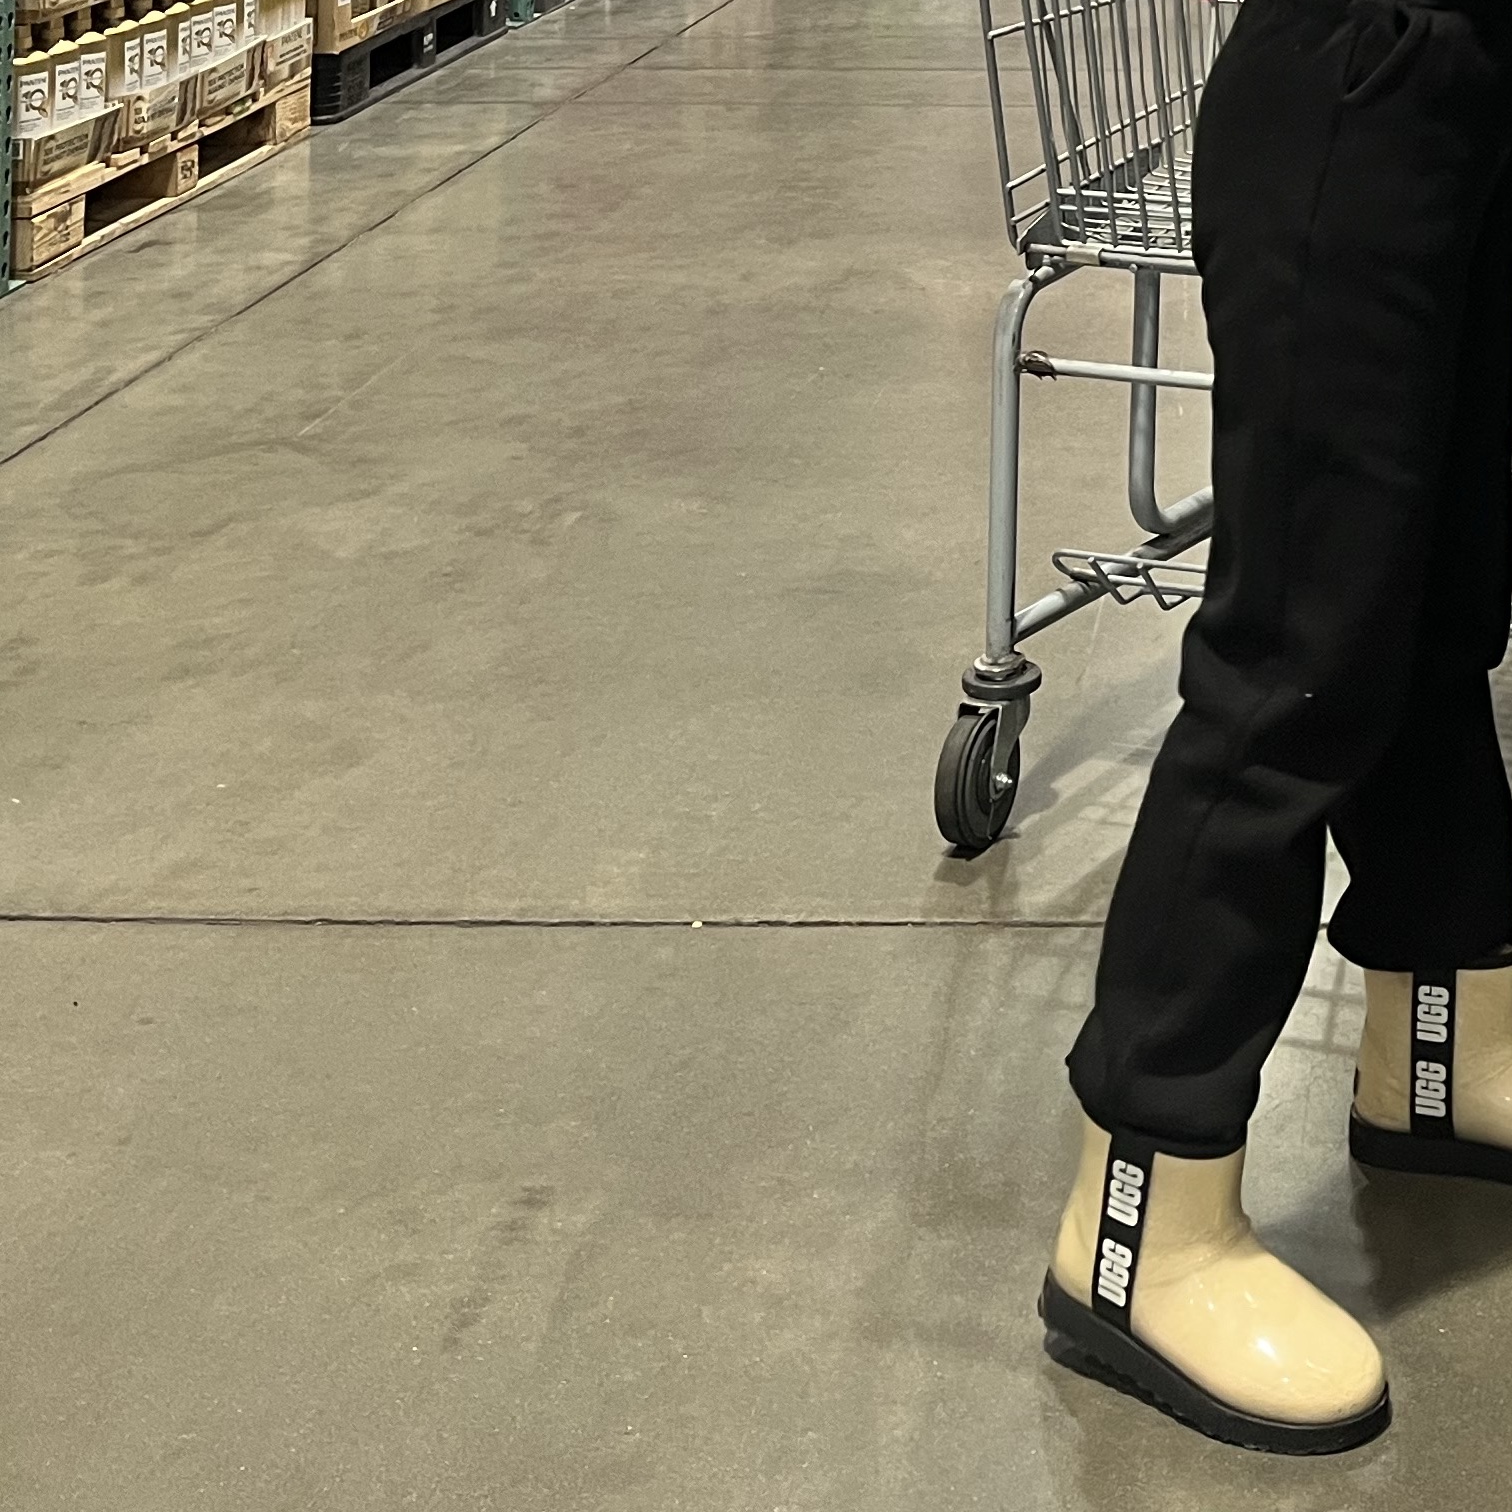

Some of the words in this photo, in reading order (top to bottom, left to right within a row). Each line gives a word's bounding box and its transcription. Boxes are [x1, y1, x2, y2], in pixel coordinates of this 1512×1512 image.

[1417, 985, 1450, 1043] UGG
[1415, 1060, 1447, 1118] UGG
[1107, 1159, 1146, 1227] UGG
[1097, 1238, 1133, 1308] UGG
